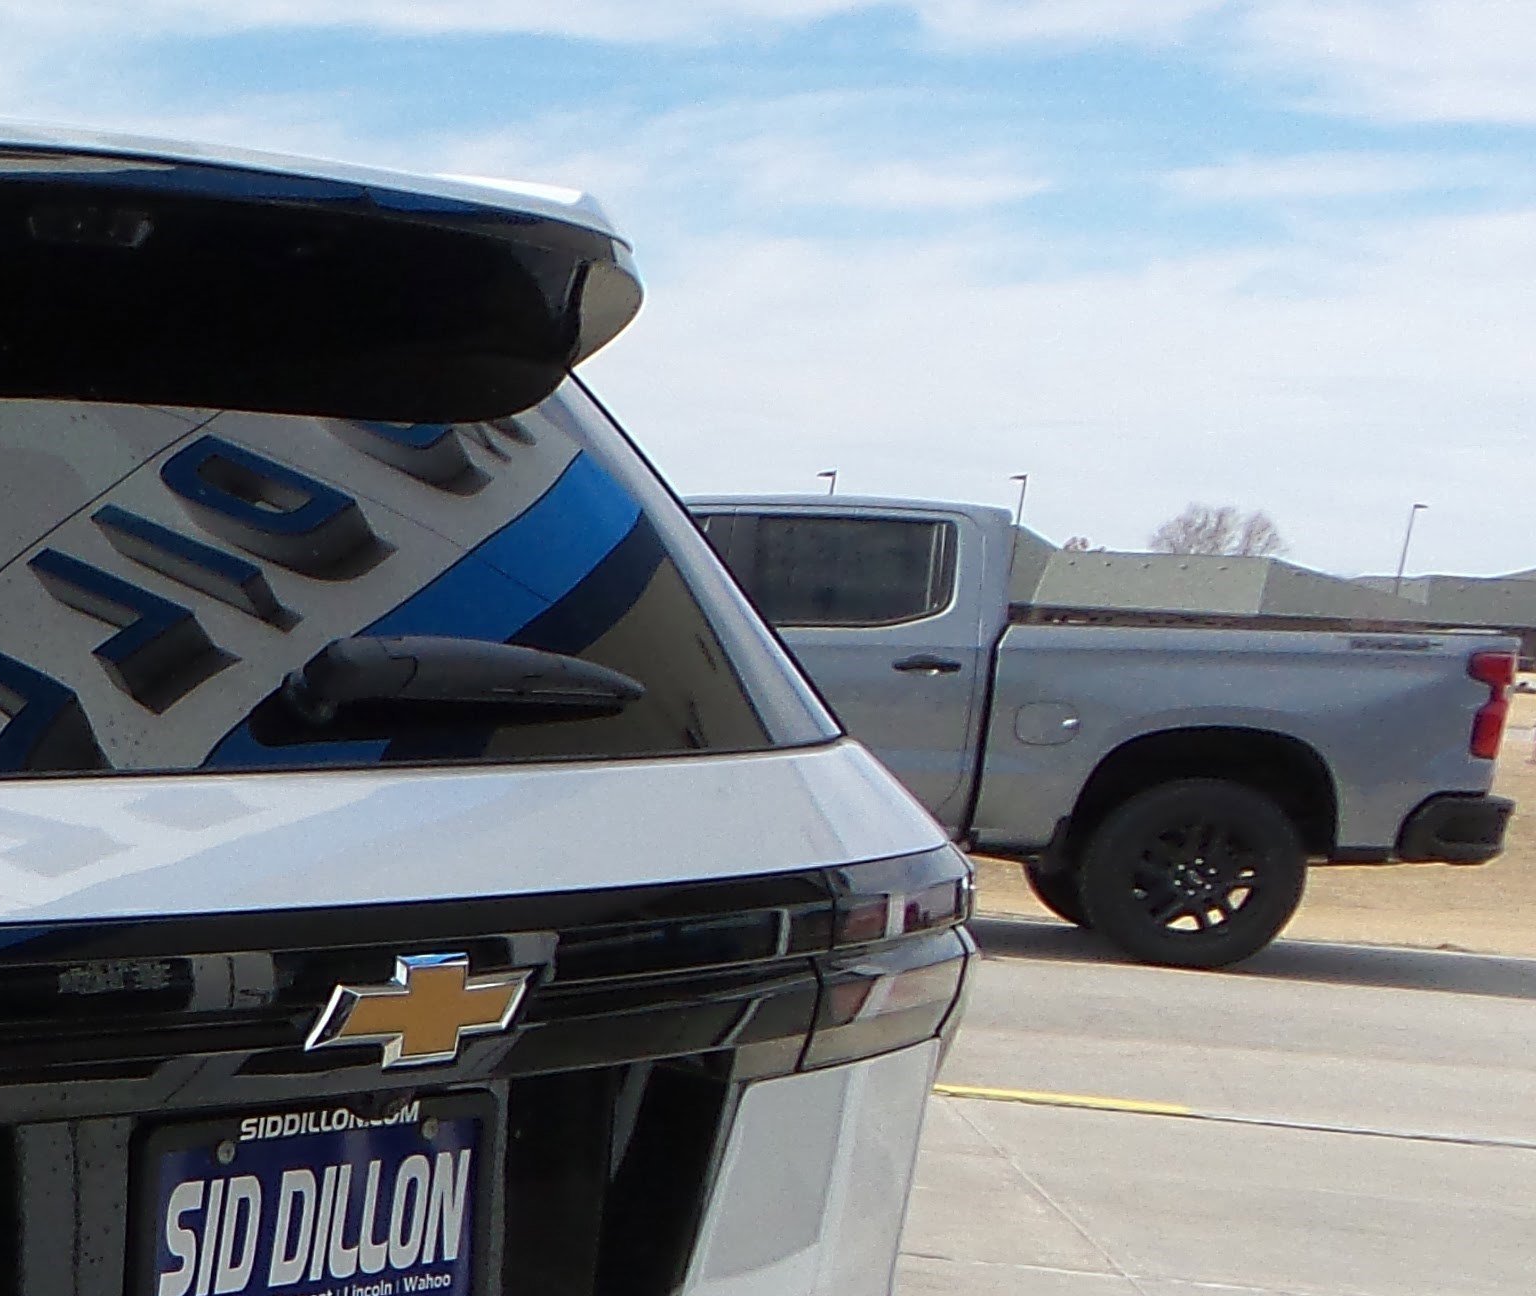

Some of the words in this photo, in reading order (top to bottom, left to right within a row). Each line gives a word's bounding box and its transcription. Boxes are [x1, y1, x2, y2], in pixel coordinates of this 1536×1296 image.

[240, 1101, 420, 1141] SIDDILLON.M
[268, 1149, 472, 1287] DILLON
[403, 1273, 452, 1292] Wahoo
